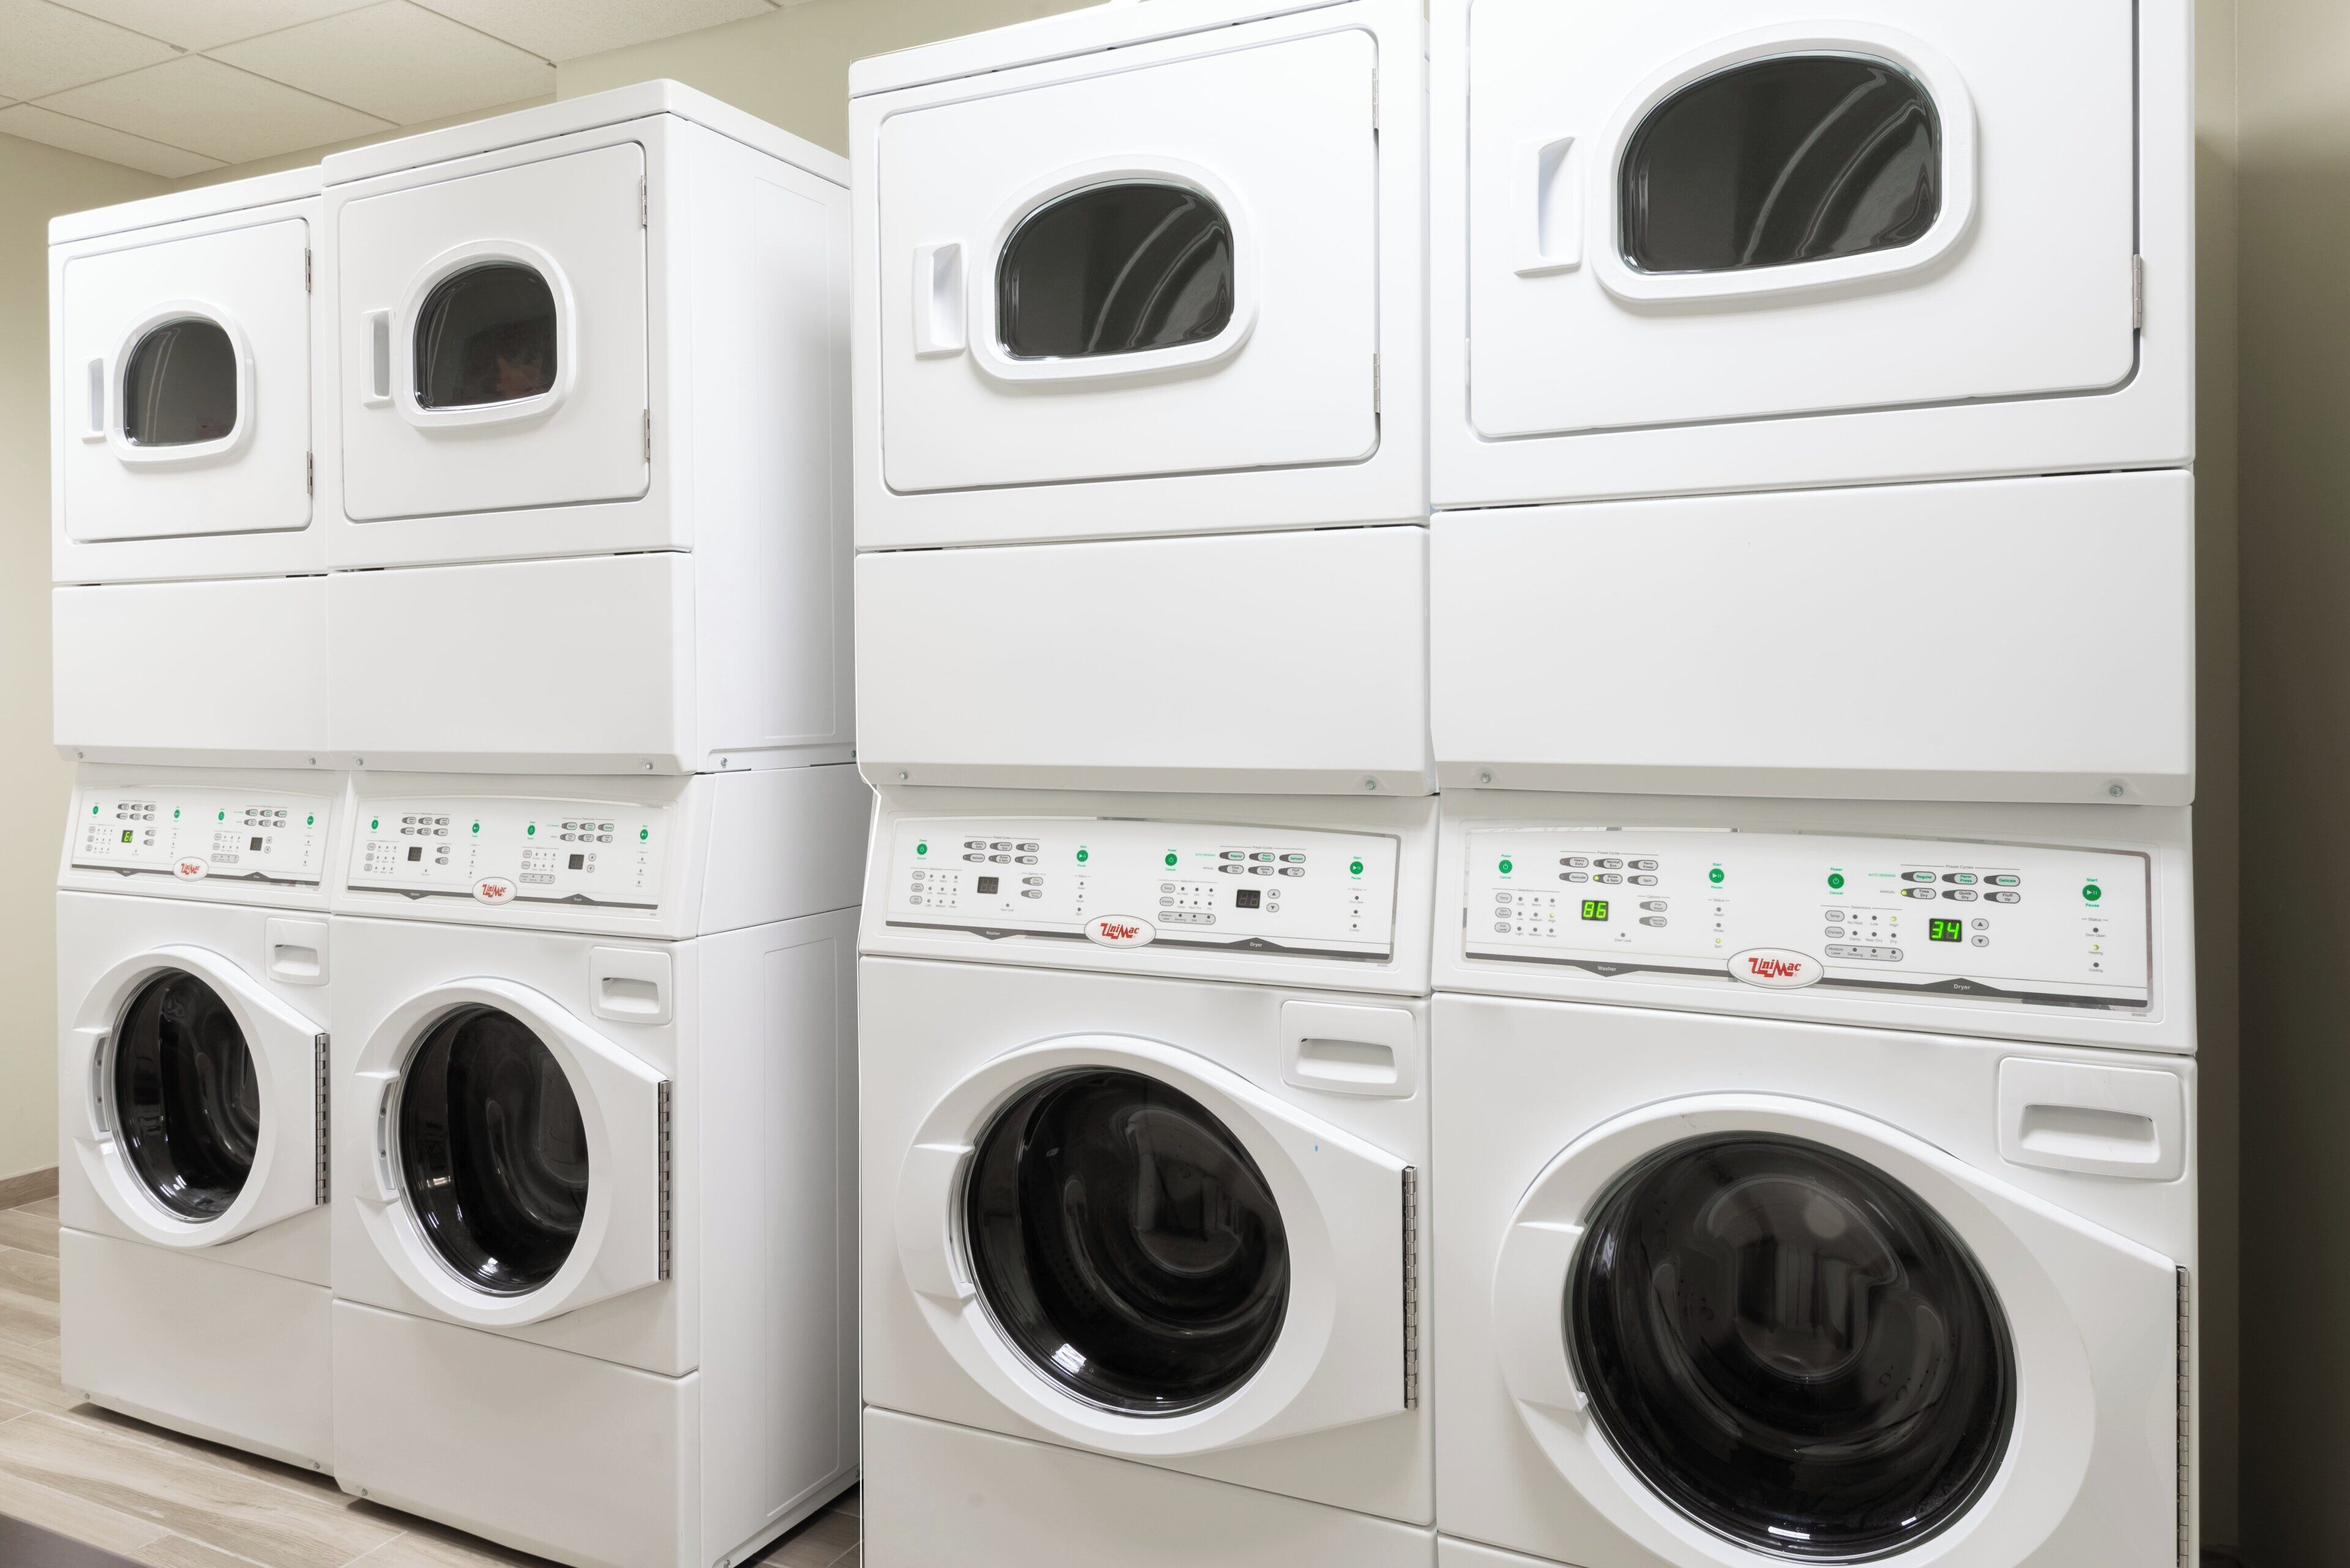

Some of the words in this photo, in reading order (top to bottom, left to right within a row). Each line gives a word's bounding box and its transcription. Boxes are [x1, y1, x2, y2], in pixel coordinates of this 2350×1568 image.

[181, 863, 200, 875] UniMac
[482, 884, 507, 898] UniMac
[1583, 902, 1606, 918] 86
[1100, 922, 1140, 939] UniMac
[1931, 921, 1959, 939] 34
[1748, 957, 1802, 978] UniMac
